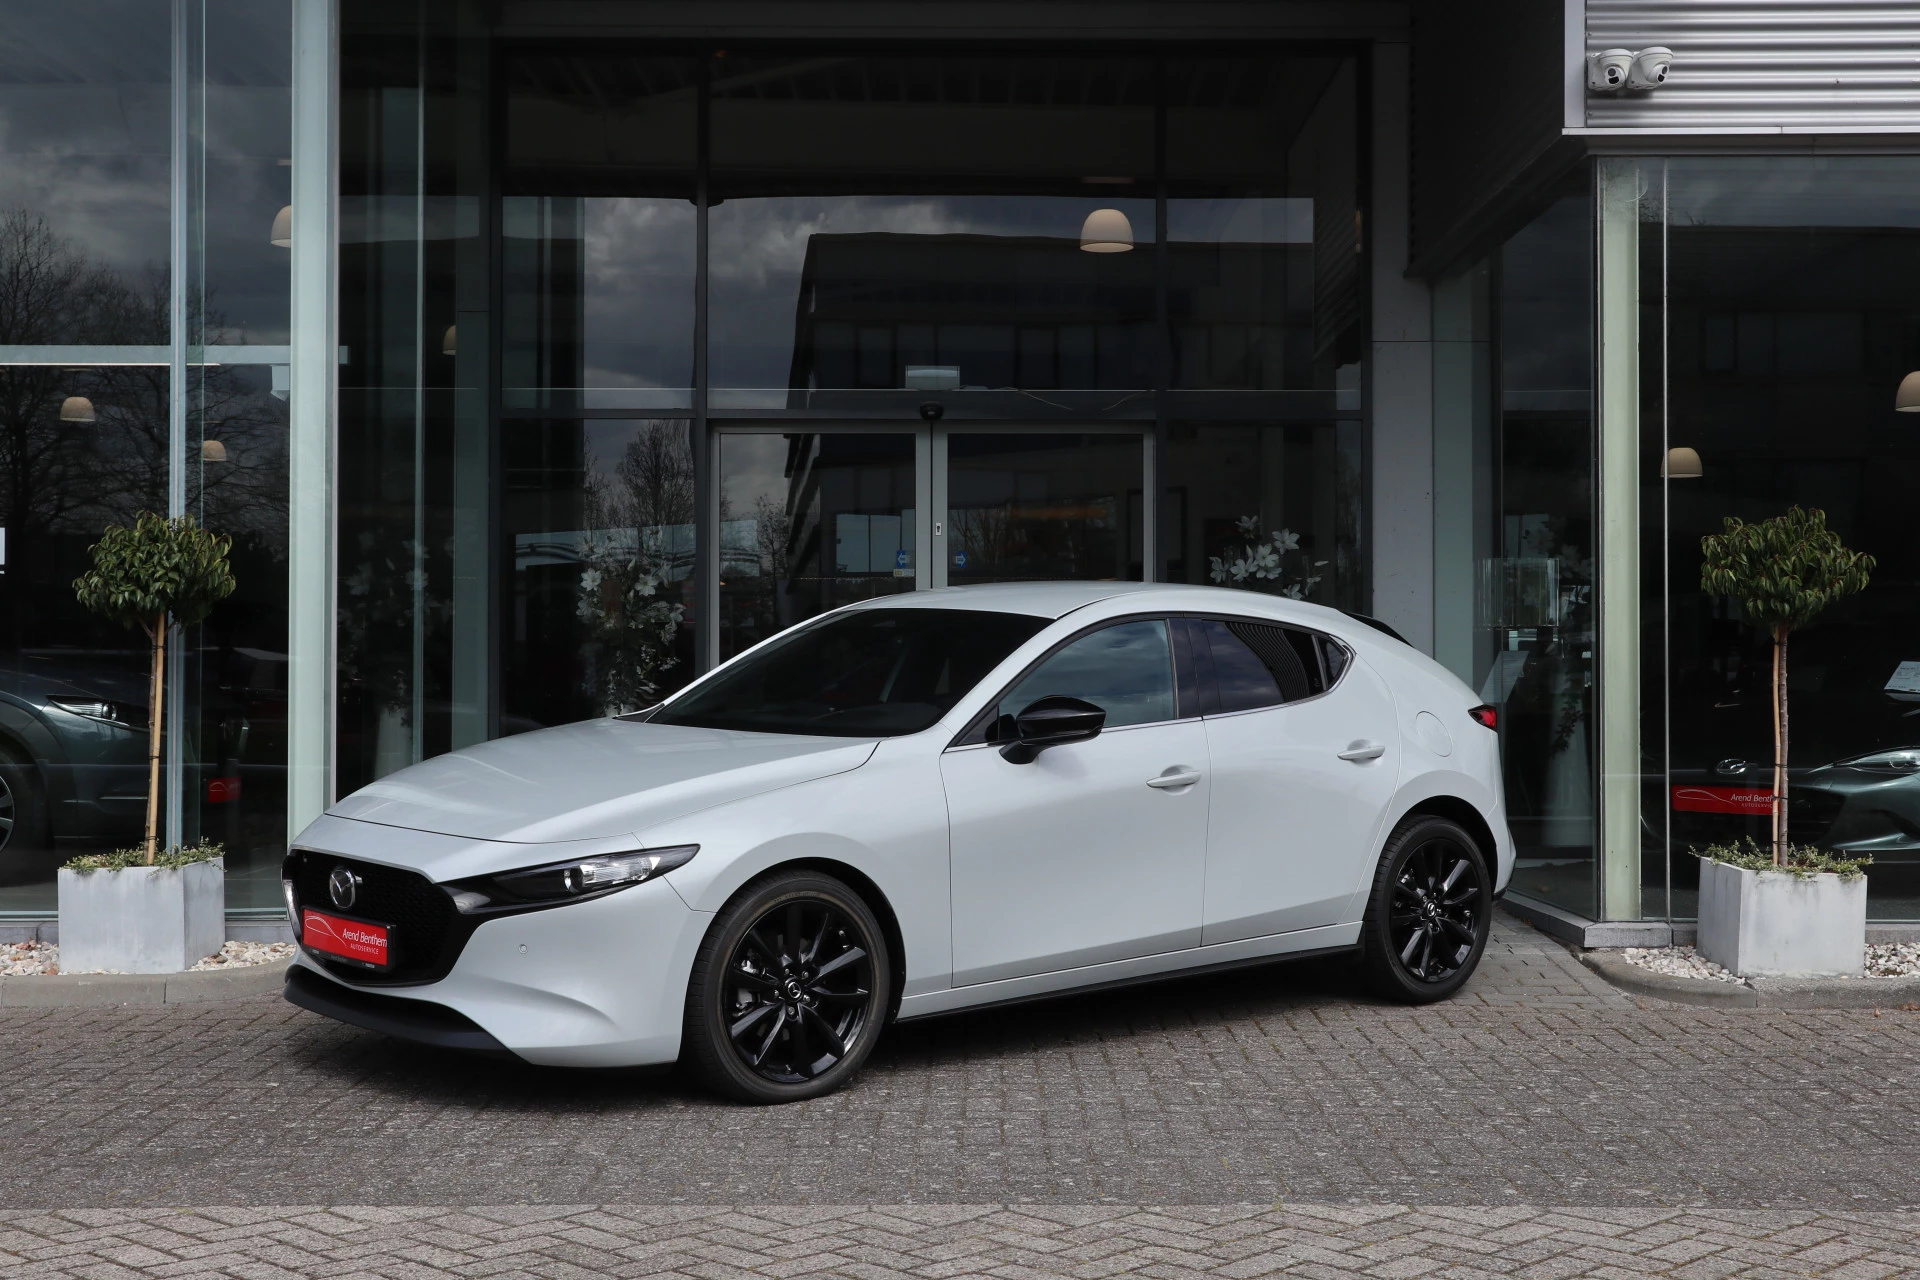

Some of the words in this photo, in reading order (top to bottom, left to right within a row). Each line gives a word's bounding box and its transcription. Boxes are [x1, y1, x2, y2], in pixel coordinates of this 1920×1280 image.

[1730, 793, 1752, 802] Arend
[342, 927, 359, 941] Arend
[360, 931, 387, 947] Benthem
[350, 943, 379, 955] AUTOSERVICE
